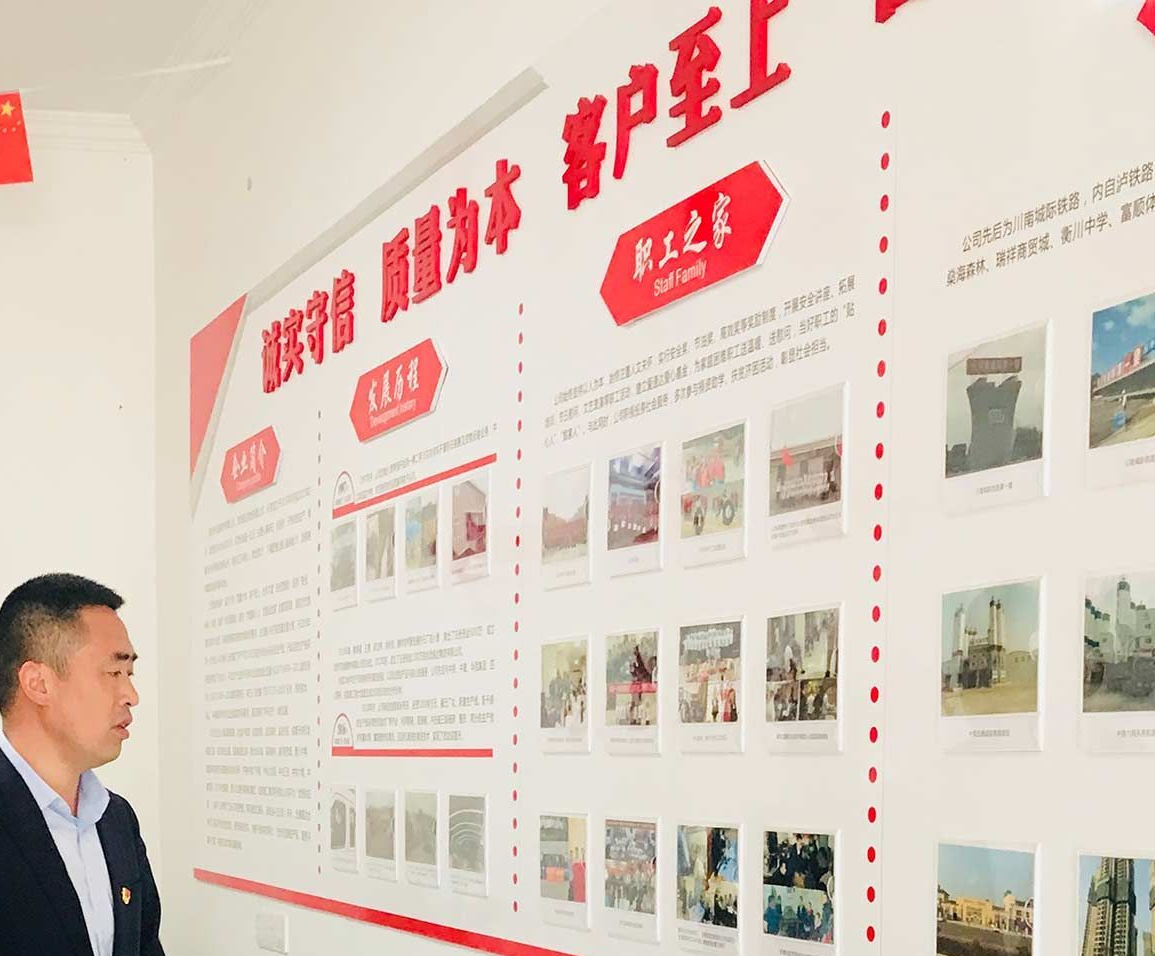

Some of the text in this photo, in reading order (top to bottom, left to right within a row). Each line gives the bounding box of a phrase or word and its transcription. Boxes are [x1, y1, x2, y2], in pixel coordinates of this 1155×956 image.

[261, 0, 792, 393] 诚实守信 质量为本 客户至上
[633, 192, 733, 283] 职工之家
[653, 258, 708, 296] Staff Family
[368, 356, 420, 414] 发展历程
